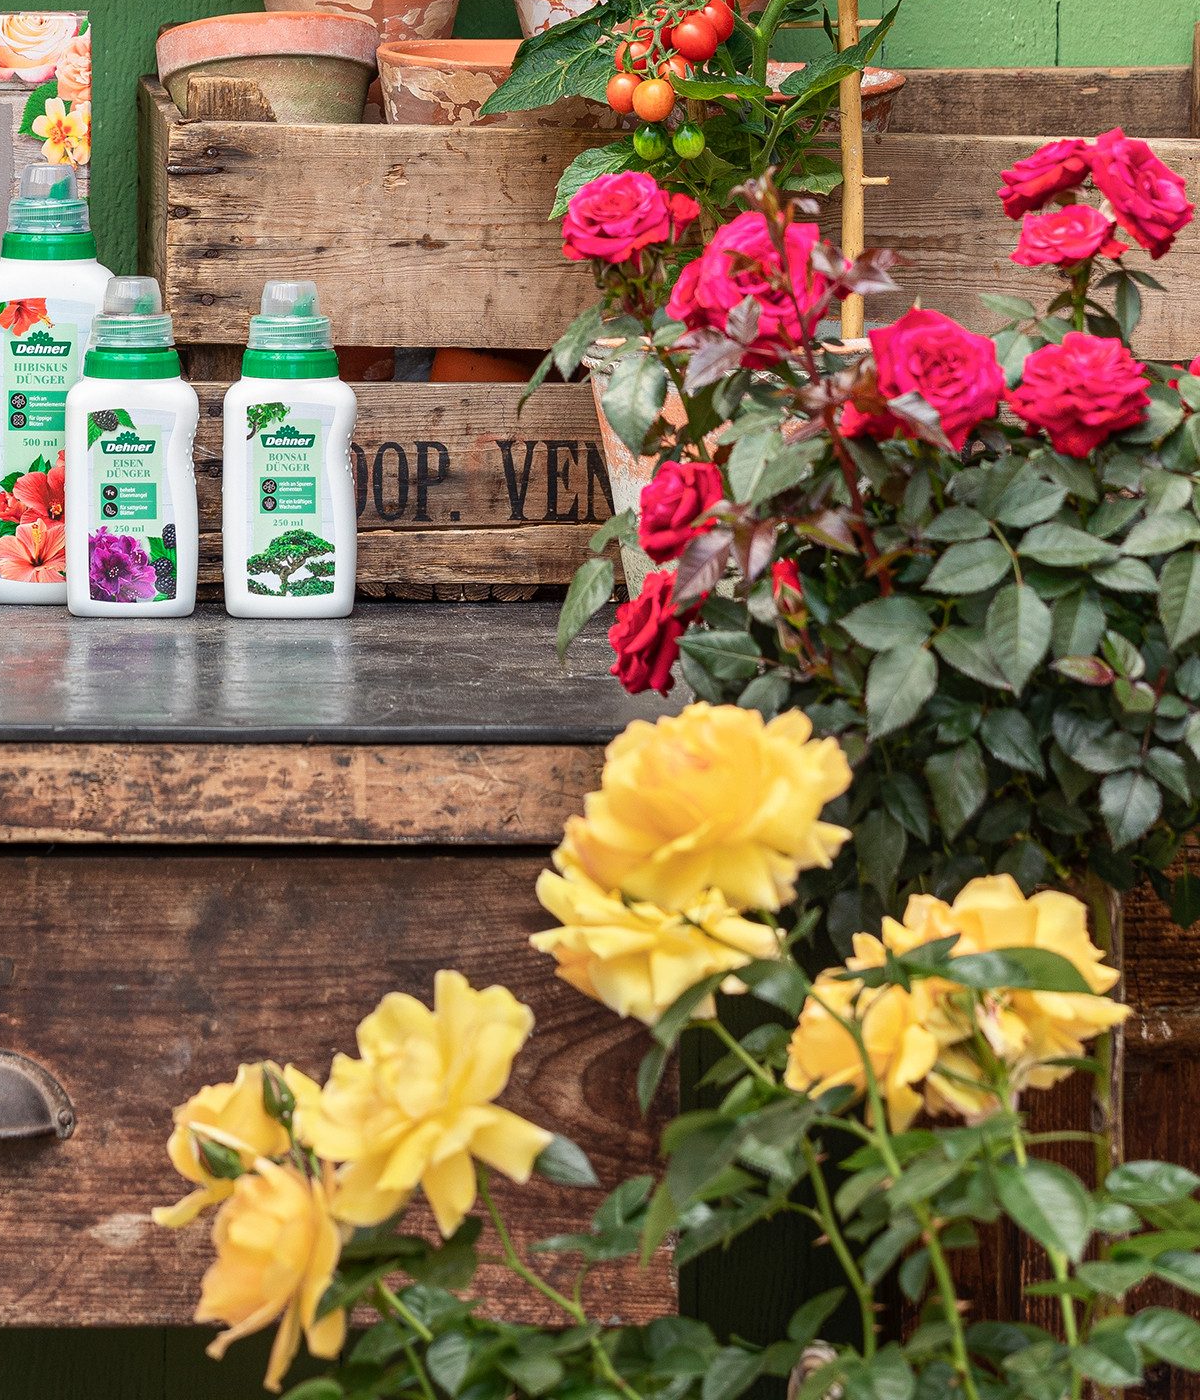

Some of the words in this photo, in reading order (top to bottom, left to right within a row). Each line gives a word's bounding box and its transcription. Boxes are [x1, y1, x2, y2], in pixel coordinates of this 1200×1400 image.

[16, 344, 67, 354] Dehner
[14, 363, 68, 372] HIBISKUS
[16, 373, 65, 385] DÜNGER
[23, 438, 40, 447] 500
[43, 438, 58, 446] ml
[265, 437, 311, 446] Dehner
[106, 443, 151, 452] Dehner
[269, 453, 307, 461] BONSAI
[113, 459, 144, 468] EISEN
[266, 462, 310, 472] DÜNGER
[107, 468, 151, 478] DÜNGER
